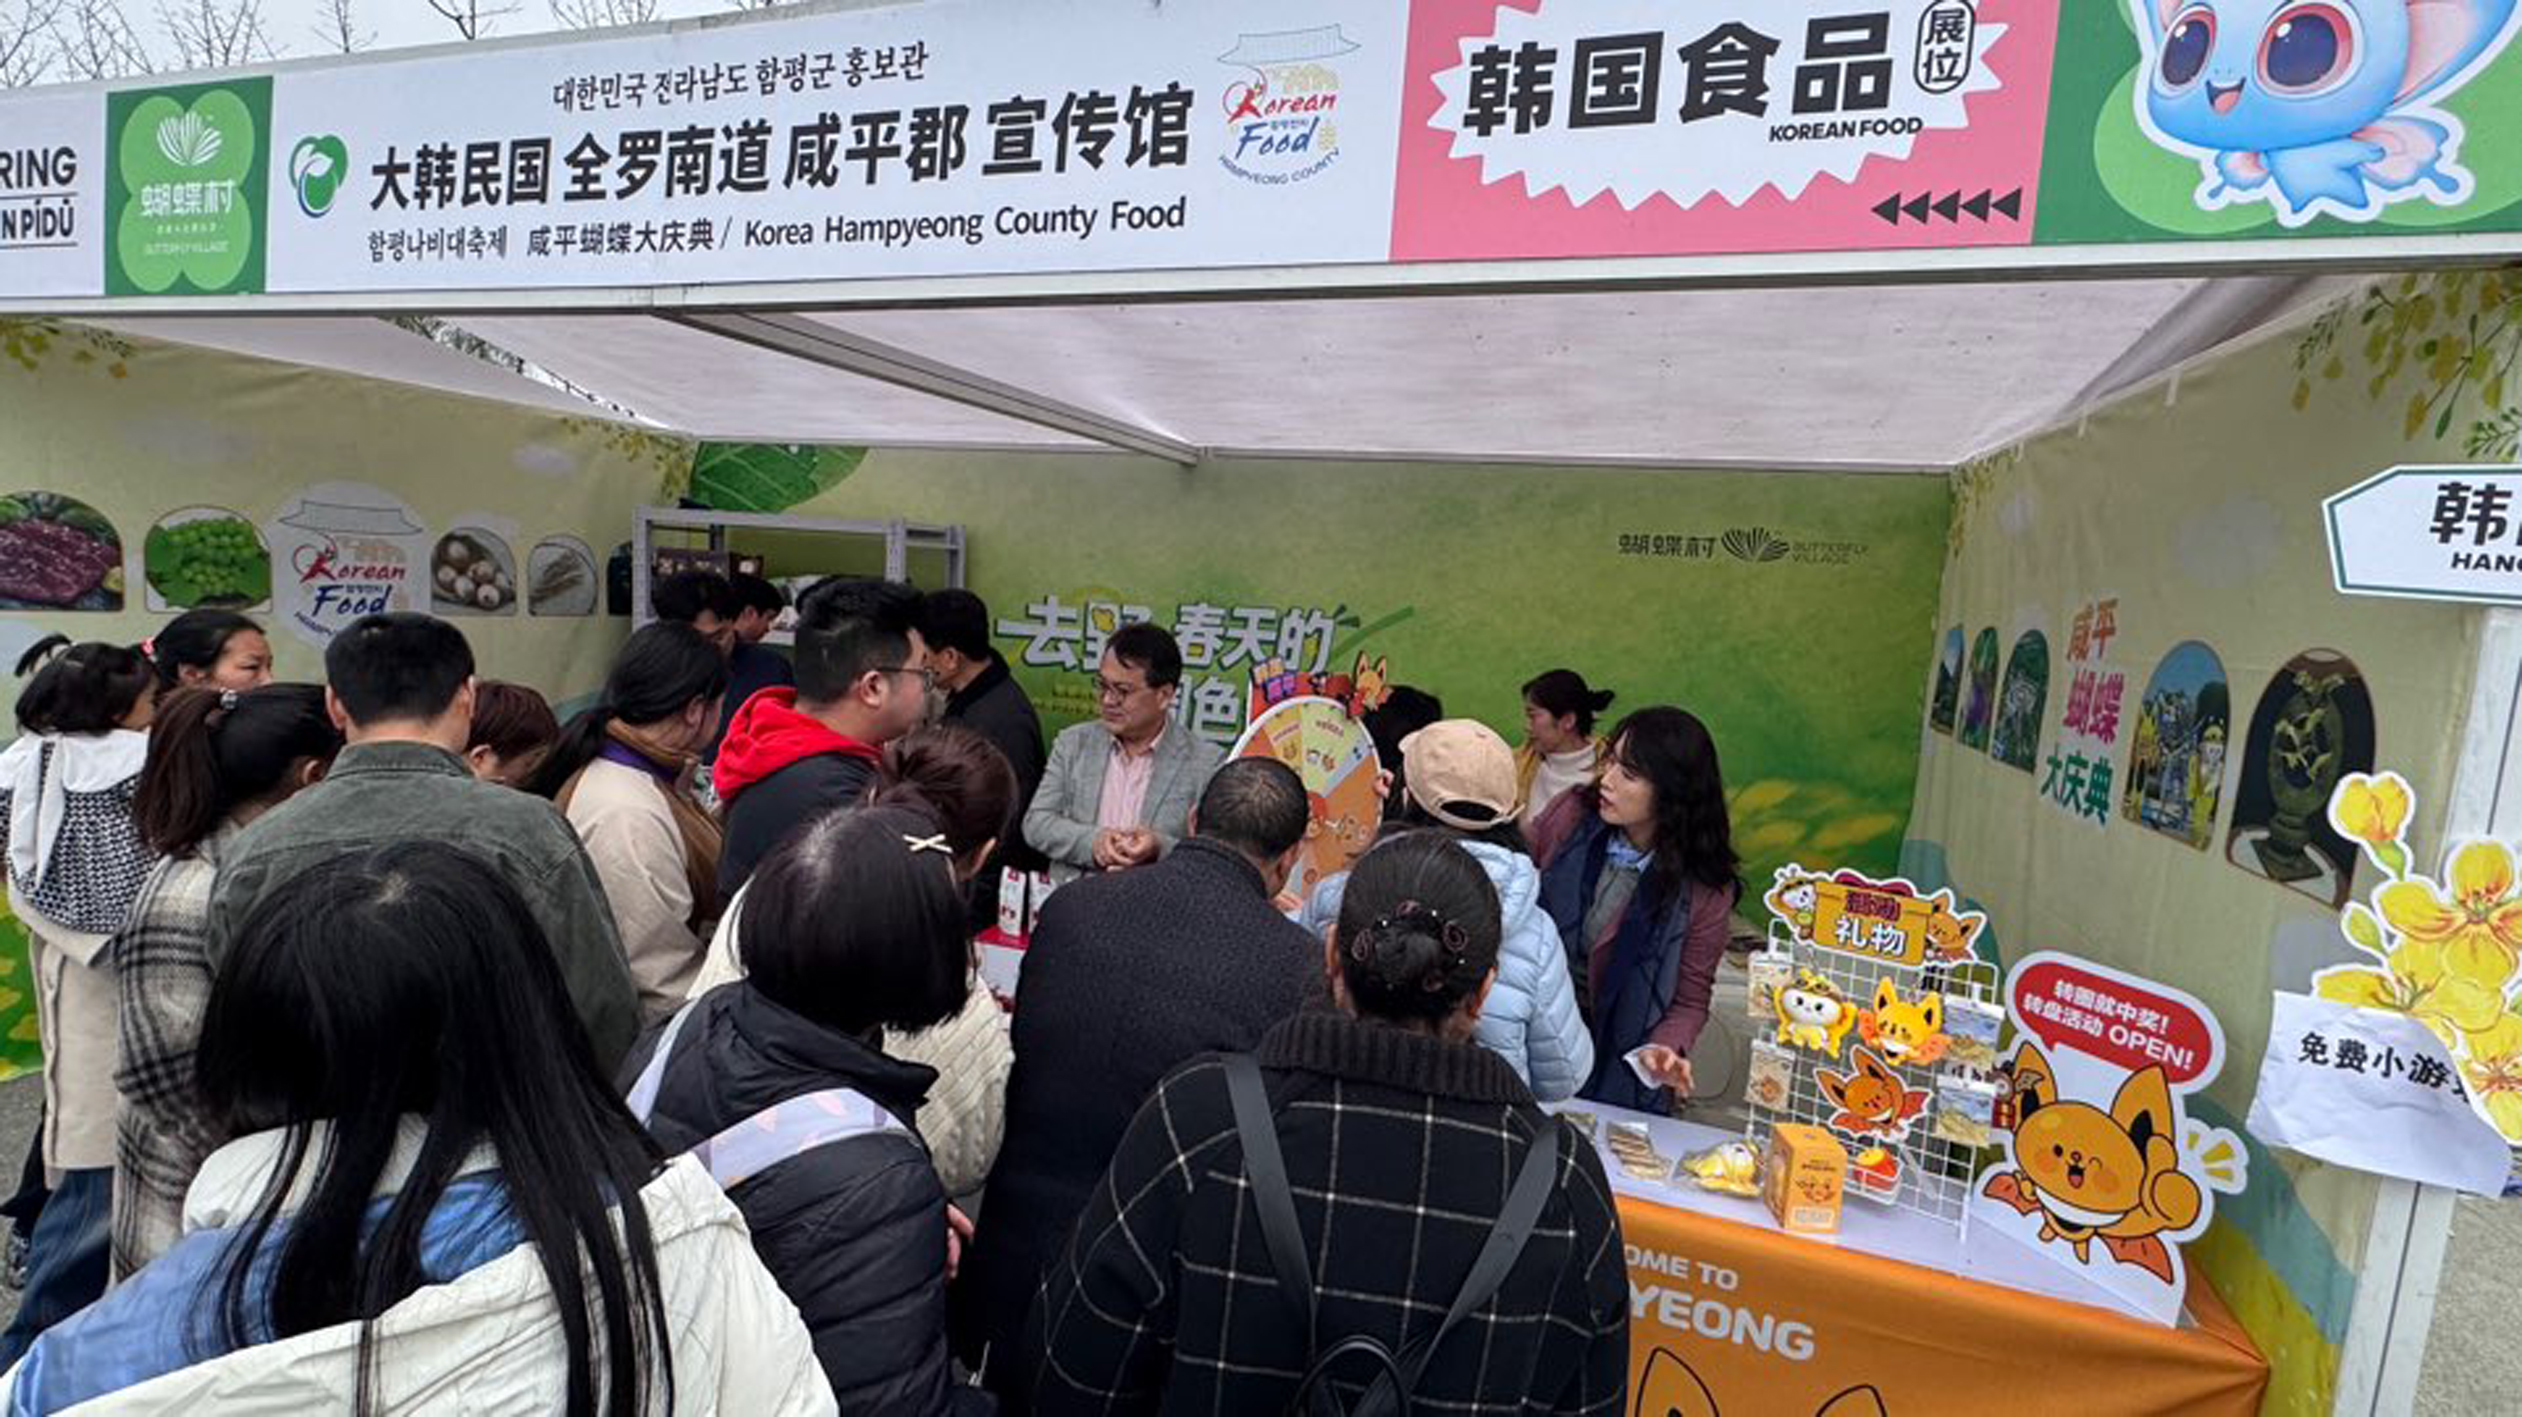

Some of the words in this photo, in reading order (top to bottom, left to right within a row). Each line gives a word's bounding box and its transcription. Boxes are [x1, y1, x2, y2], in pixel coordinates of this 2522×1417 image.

[1923, 8, 1966, 84] 展位
[553, 73, 647, 112] 대한민국
[654, 62, 749, 105] 전라남도
[755, 52, 836, 96] 함평군
[843, 41, 929, 87] 홍보관
[1463, 12, 1893, 137] 韩国食品
[1226, 87, 1337, 124] Korean
[1769, 120, 1857, 142] KOREAN
[1859, 117, 1924, 137] FOOD
[370, 137, 552, 211] 大韩民国
[563, 119, 772, 201] 全罗南道
[783, 104, 970, 189] 咸平郡
[981, 80, 1194, 176] 宣传馆
[1235, 116, 1320, 159] Food
[140, 178, 236, 217] 蝴蝶村
[367, 226, 508, 262] 함평나비대축제
[744, 219, 814, 248] Korea
[825, 210, 984, 248] Hampyeong
[995, 204, 1098, 240] County
[1111, 196, 1187, 231] Food
[2430, 482, 2522, 546] 韩
[299, 551, 405, 583] Korean
[311, 584, 392, 617] Food
[2067, 598, 2118, 661] 咸平
[2062, 668, 2124, 744] 蝴蝶
[2041, 743, 2114, 826] 大庆典
[1835, 915, 1906, 957] 礼物
[2109, 1025, 2194, 1071] OPEN!
[1696, 1261, 1739, 1291] TO
